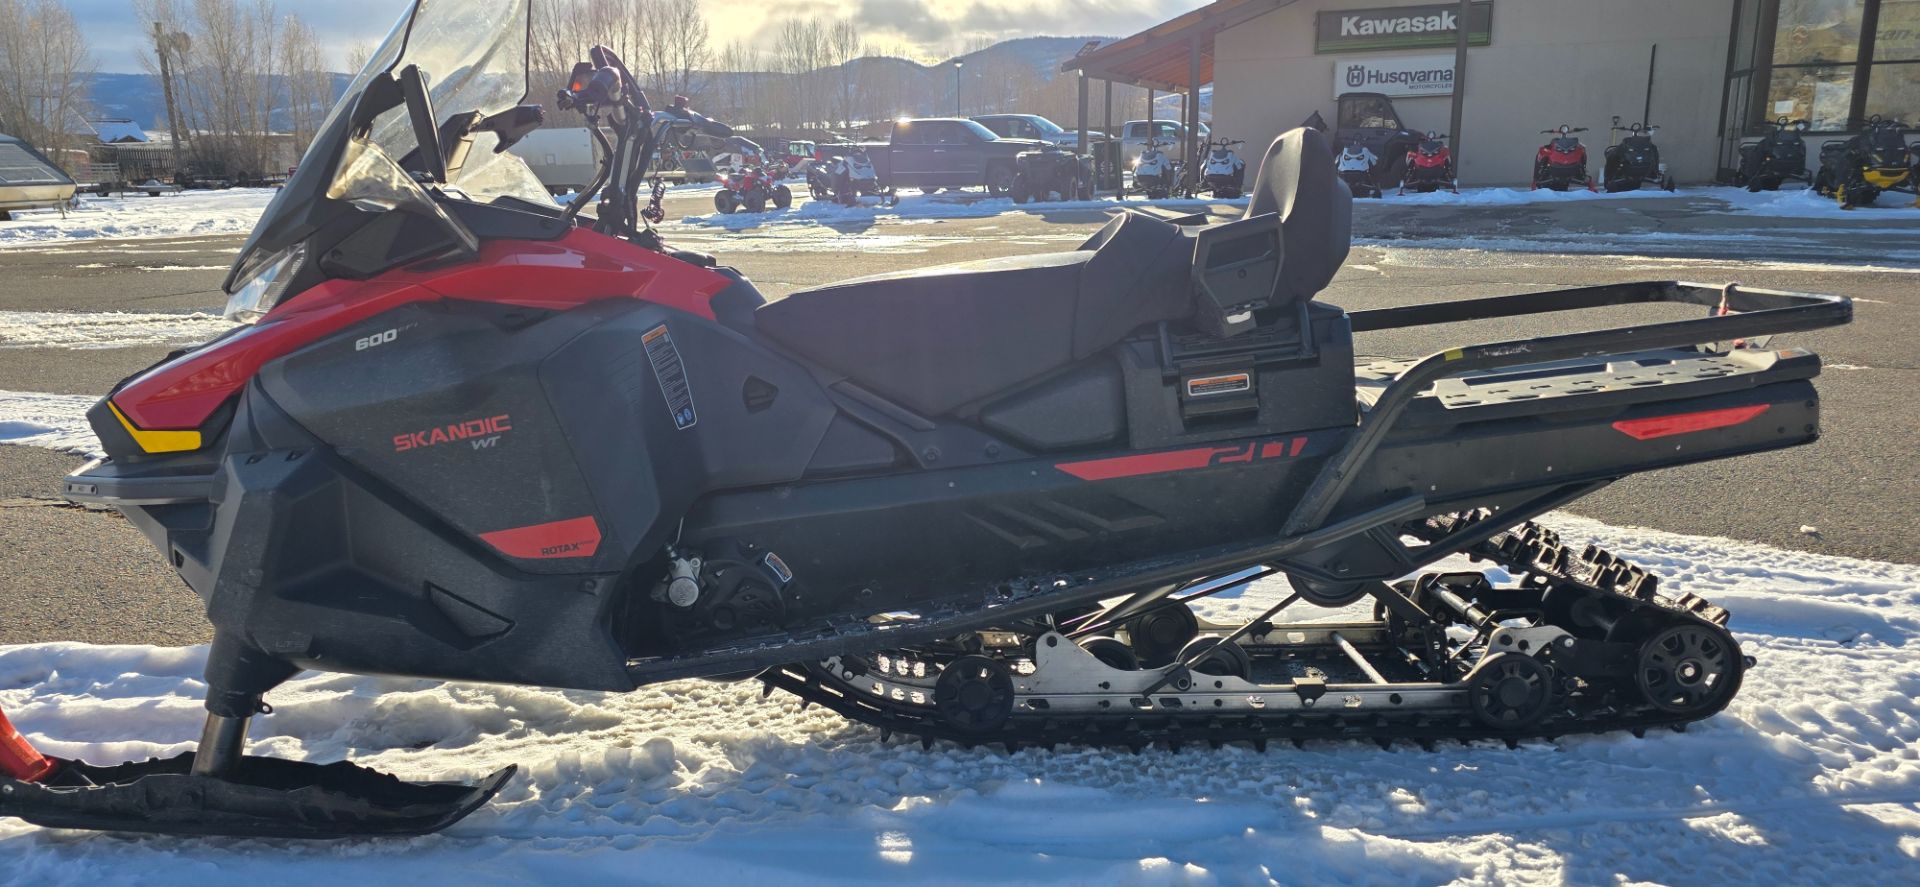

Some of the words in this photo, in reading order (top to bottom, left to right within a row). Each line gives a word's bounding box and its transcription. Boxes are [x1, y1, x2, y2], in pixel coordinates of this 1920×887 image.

[1341, 10, 1457, 36] Kawasak
[1367, 68, 1453, 86] Husqvarna
[355, 328, 398, 351] 600
[392, 414, 513, 452] SKANDIC
[470, 435, 501, 450] WT
[541, 542, 580, 555] ROTAX
